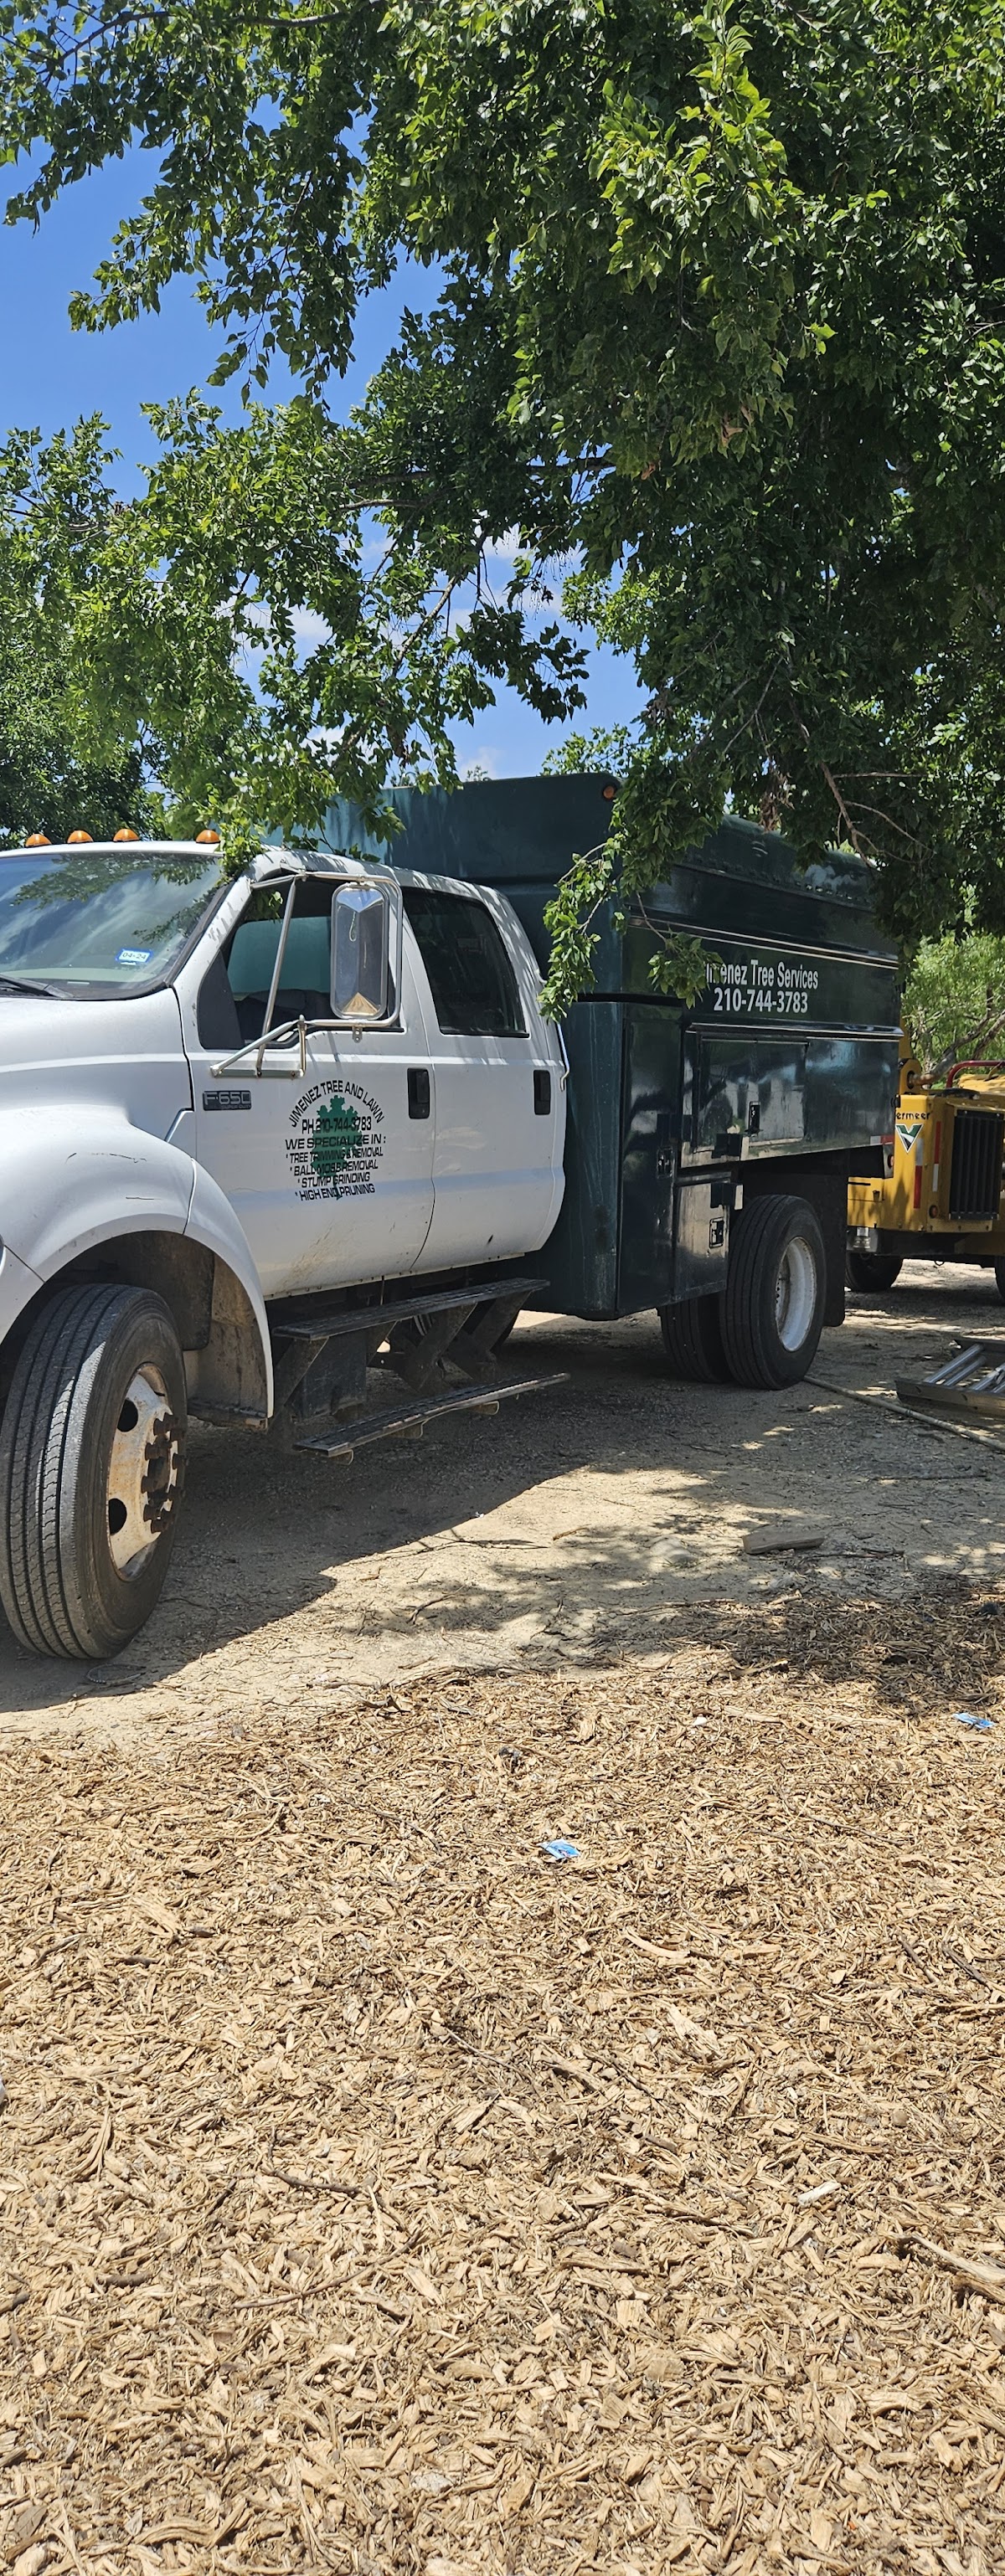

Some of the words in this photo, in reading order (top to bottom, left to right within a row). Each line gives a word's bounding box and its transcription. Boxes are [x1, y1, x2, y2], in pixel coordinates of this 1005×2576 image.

[751, 959, 775, 986] Tree
[777, 962, 818, 990] Services
[714, 987, 808, 1013] 210-744-3783
[289, 1086, 322, 1128] JIMENEZ
[321, 1080, 343, 1095] TREE
[344, 1082, 364, 1100] AND
[362, 1092, 385, 1123] LAWN
[302, 1118, 314, 1134] PH
[315, 1116, 372, 1134] 210-744-3783
[285, 1139, 305, 1150] WE
[307, 1134, 369, 1149] SPECIALIZE
[290, 1152, 309, 1164] TREE
[310, 1149, 345, 1162] TRIMMING
[352, 1146, 384, 1159] REMOVAL
[294, 1165, 316, 1176] BALL
[342, 1159, 379, 1172] REMOVAL
[302, 1175, 332, 1188] STUMP
[332, 1172, 370, 1185] GRINDING
[299, 1190, 322, 1201] HIGH
[339, 1183, 375, 1197] PRUNING
